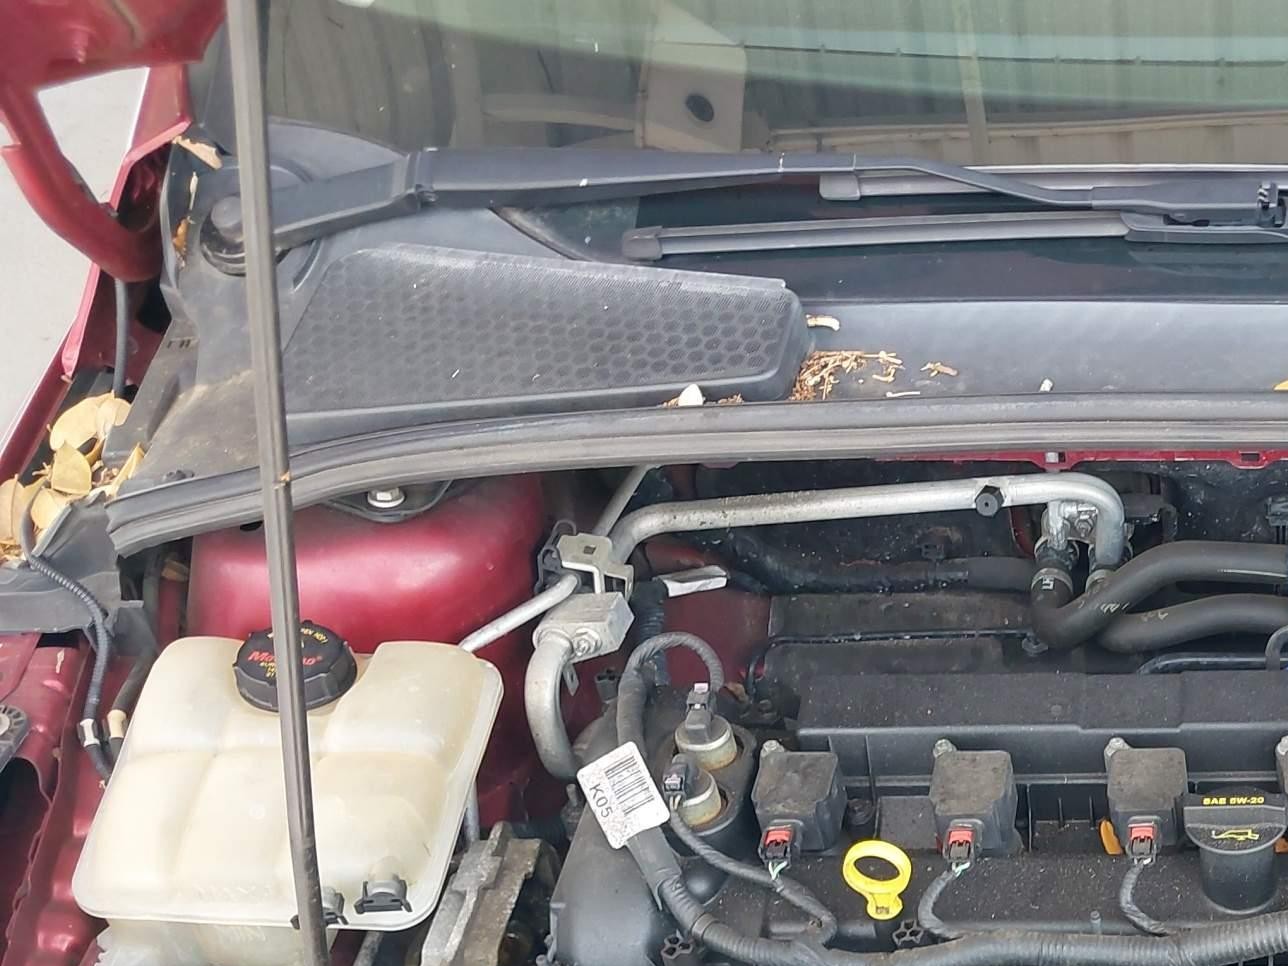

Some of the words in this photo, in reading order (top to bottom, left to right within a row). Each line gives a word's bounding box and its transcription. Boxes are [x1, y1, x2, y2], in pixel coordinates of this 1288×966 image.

[589, 783, 613, 818] K05
[1203, 797, 1227, 805] SAE
[1229, 796, 1265, 805] 5W-20
